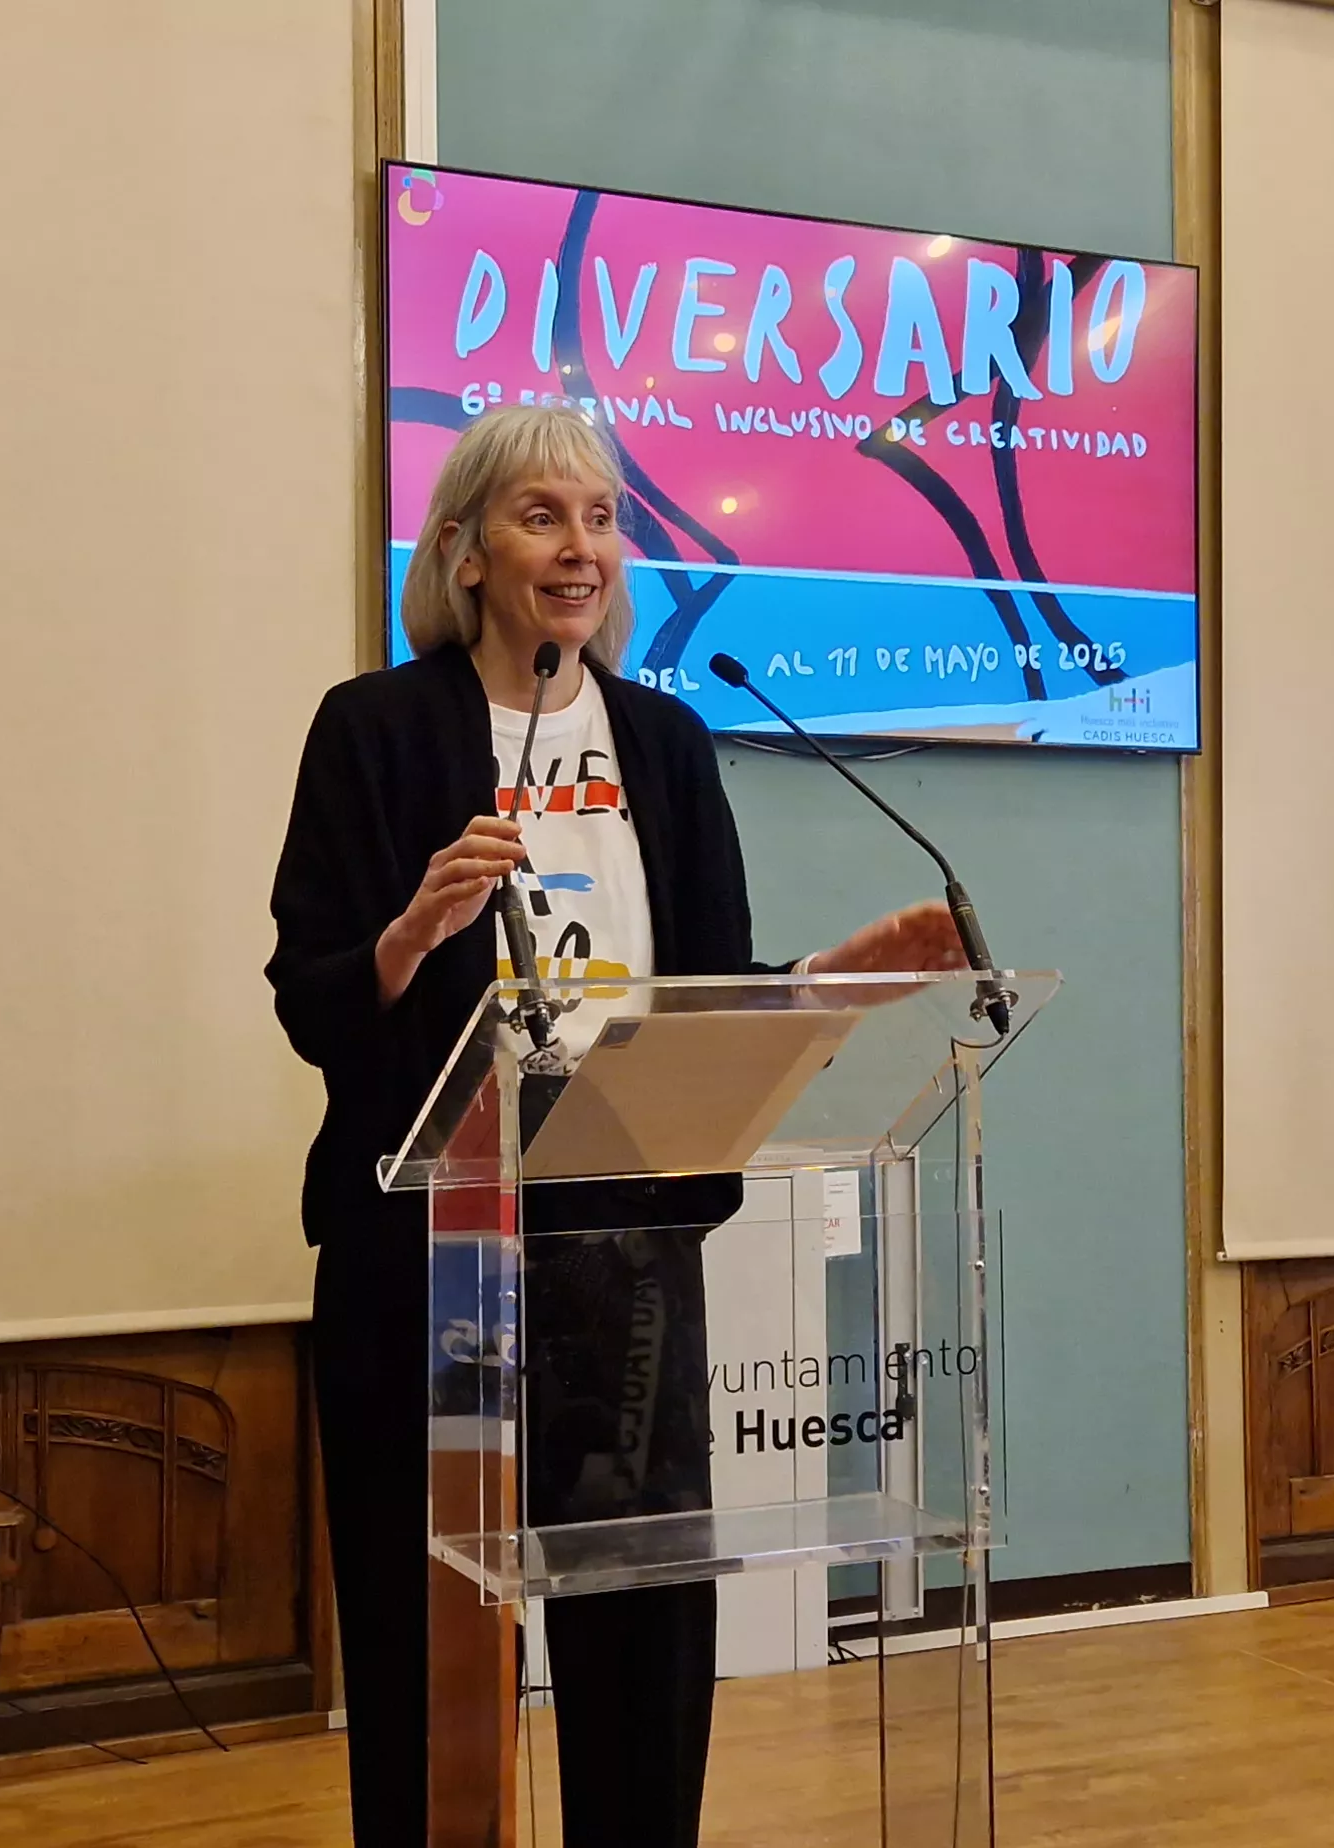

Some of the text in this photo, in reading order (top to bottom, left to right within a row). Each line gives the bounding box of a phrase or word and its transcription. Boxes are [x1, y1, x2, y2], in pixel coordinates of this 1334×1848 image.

[455, 248, 1146, 405] DIVERSARIO
[716, 402, 873, 440] INCLUSIVO
[890, 418, 927, 446] DE
[946, 420, 1147, 458] CREATIVIDAD
[638, 641, 1126, 695] DEL AL 11 DE MAYO DE 2025
[1083, 730, 1175, 743] CADIS HUESCA
[707, 1339, 977, 1394] yuntamiento
[736, 1409, 904, 1453] Huesca
